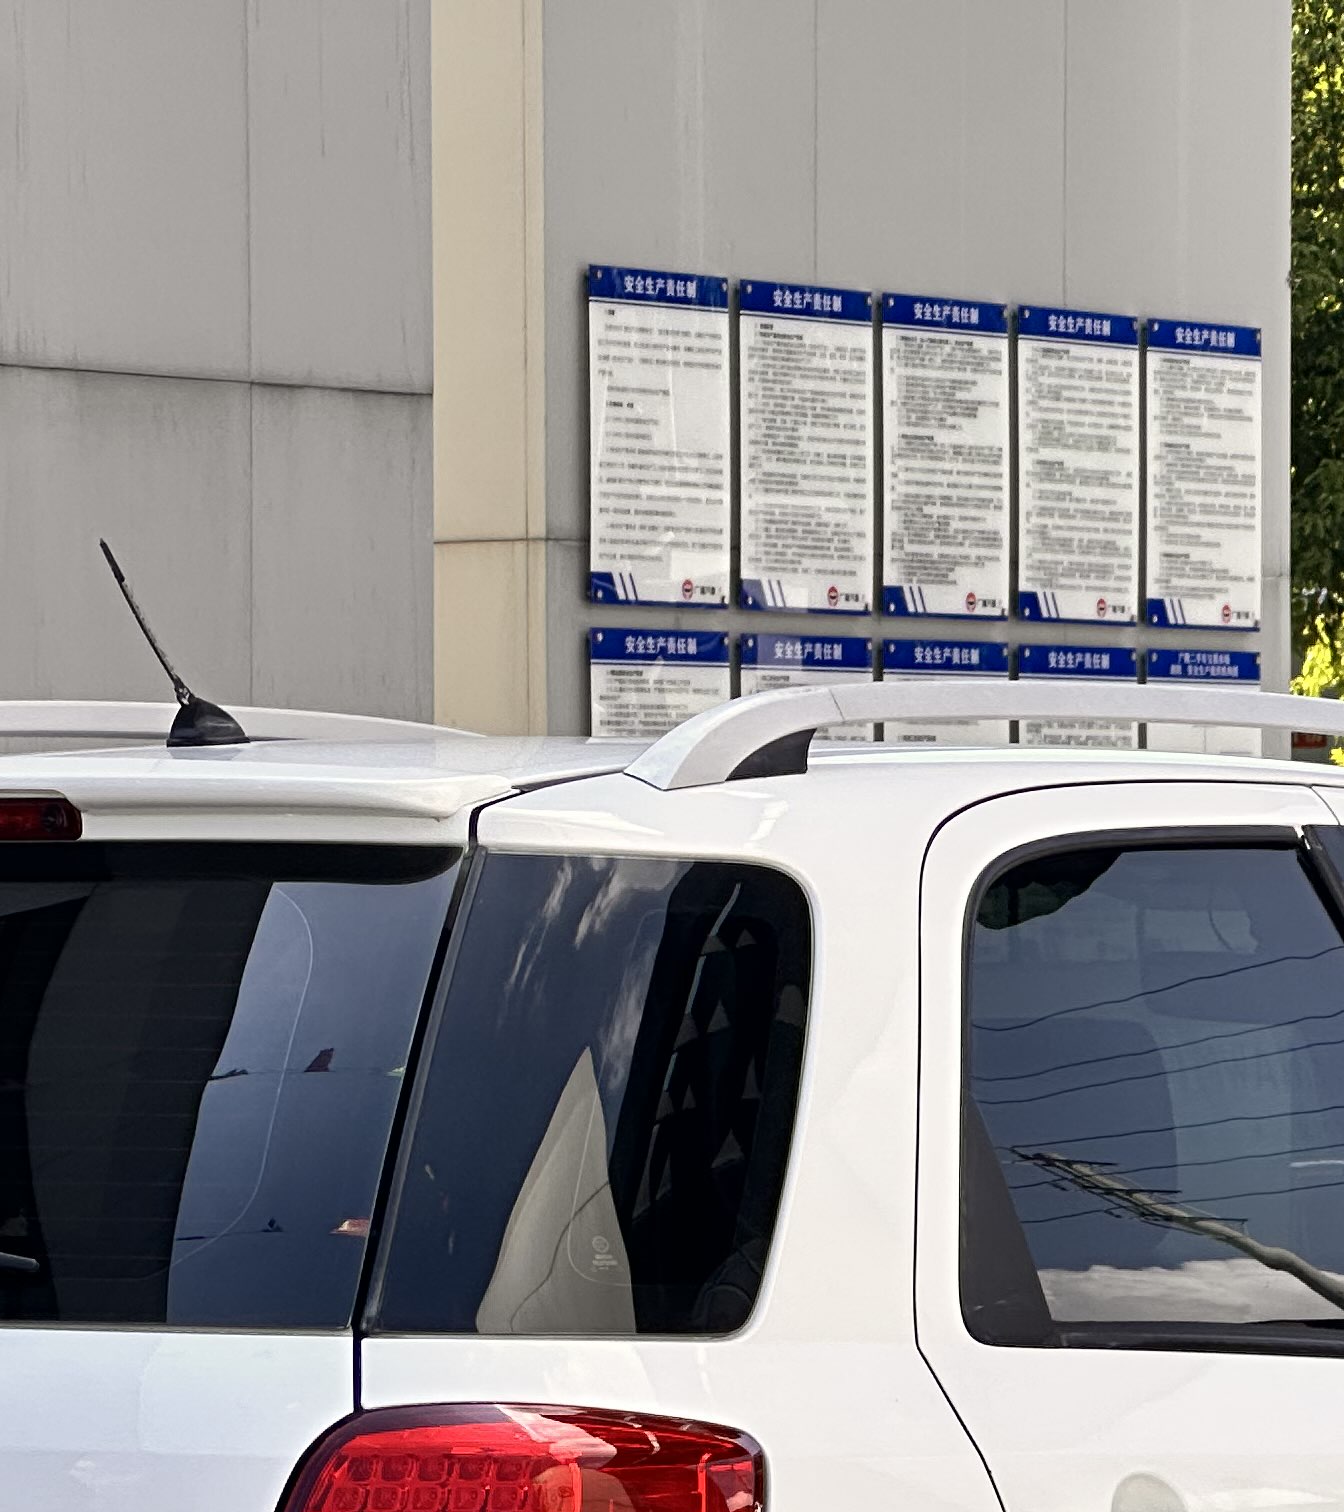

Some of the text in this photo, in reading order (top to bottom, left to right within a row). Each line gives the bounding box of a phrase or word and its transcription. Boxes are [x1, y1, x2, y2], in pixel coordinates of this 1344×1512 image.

[624, 275, 697, 300] 安全生产责任制
[773, 289, 843, 313] 安全生产责任制
[913, 302, 979, 325] 安全生产责任制
[1047, 315, 1112, 338] 安全生产责任制
[1174, 327, 1236, 349] 安全生产责任制
[625, 636, 697, 655] 安全生产责任制
[773, 640, 843, 661] 安全生产责任制
[913, 645, 980, 665] 安全生产责任制
[1047, 650, 1110, 670] 安全生产责任制
